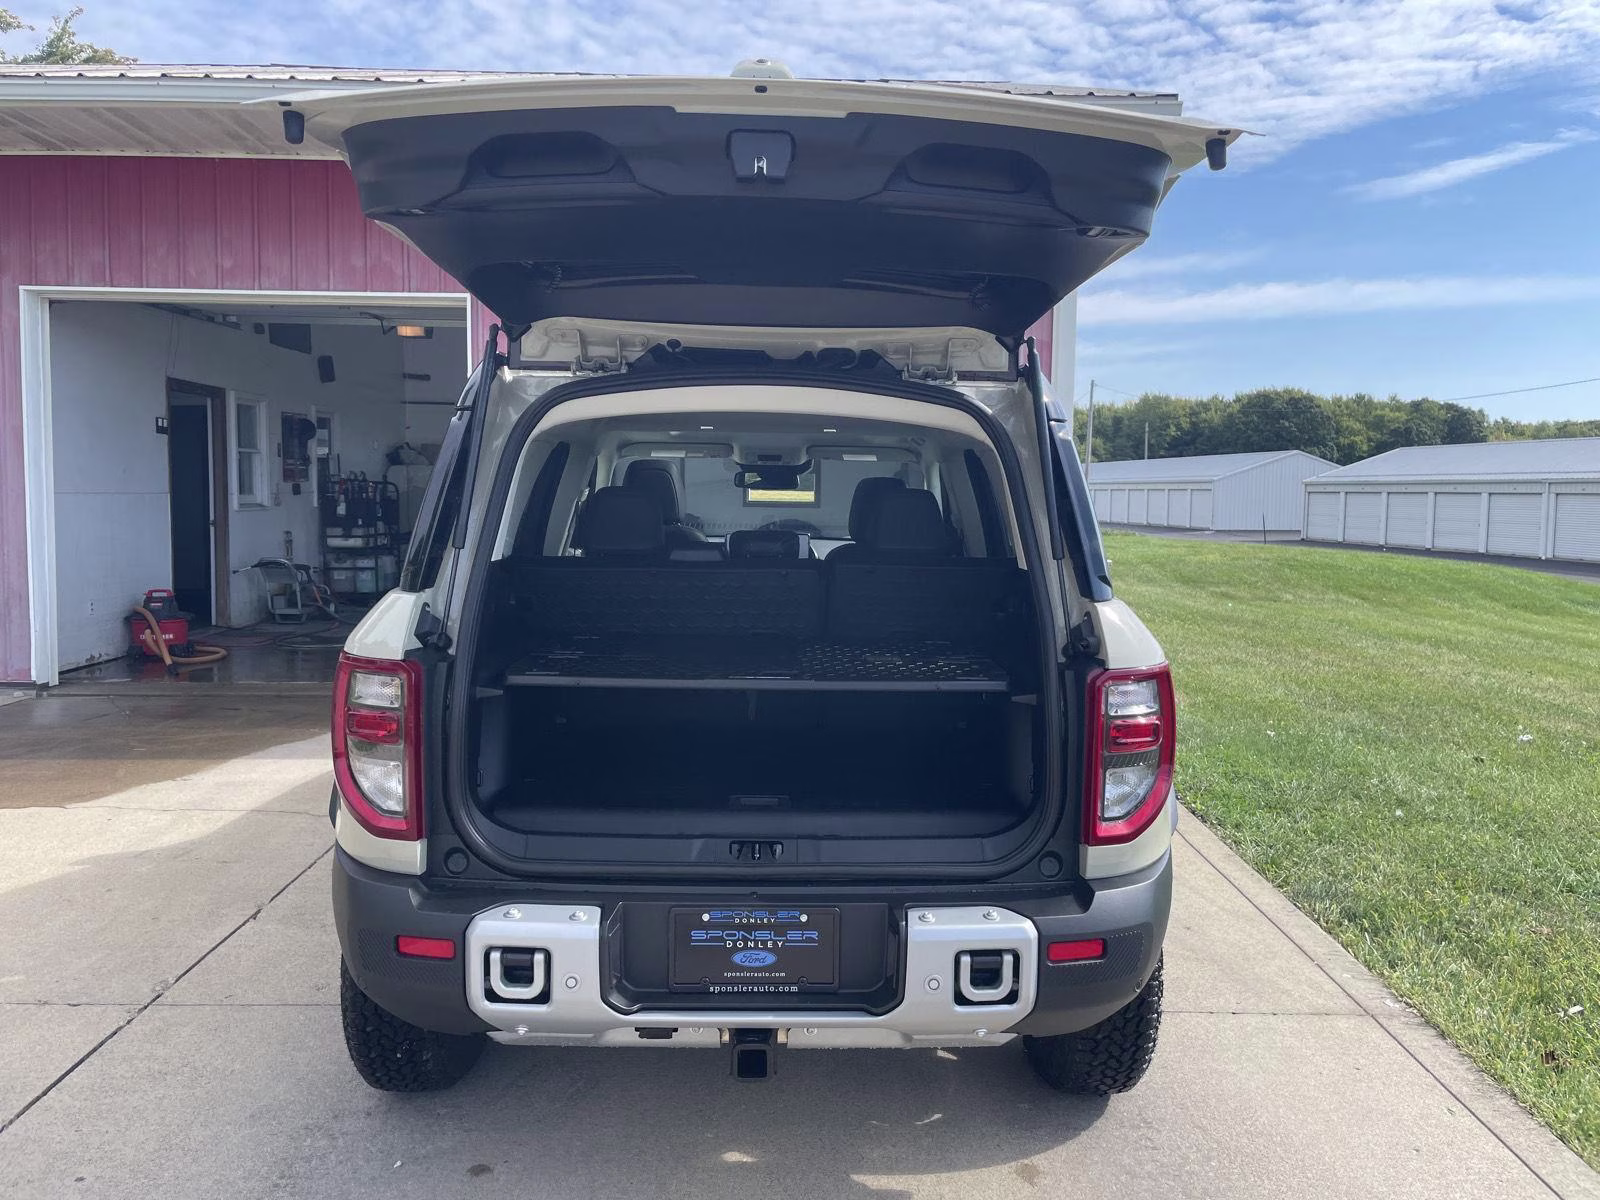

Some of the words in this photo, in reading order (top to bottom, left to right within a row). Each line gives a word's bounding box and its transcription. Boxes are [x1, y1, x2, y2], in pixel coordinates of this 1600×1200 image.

[690, 930, 819, 940] SPONSLER
[740, 952, 767, 964] Ford
[709, 984, 799, 993] sponslerauto.com
